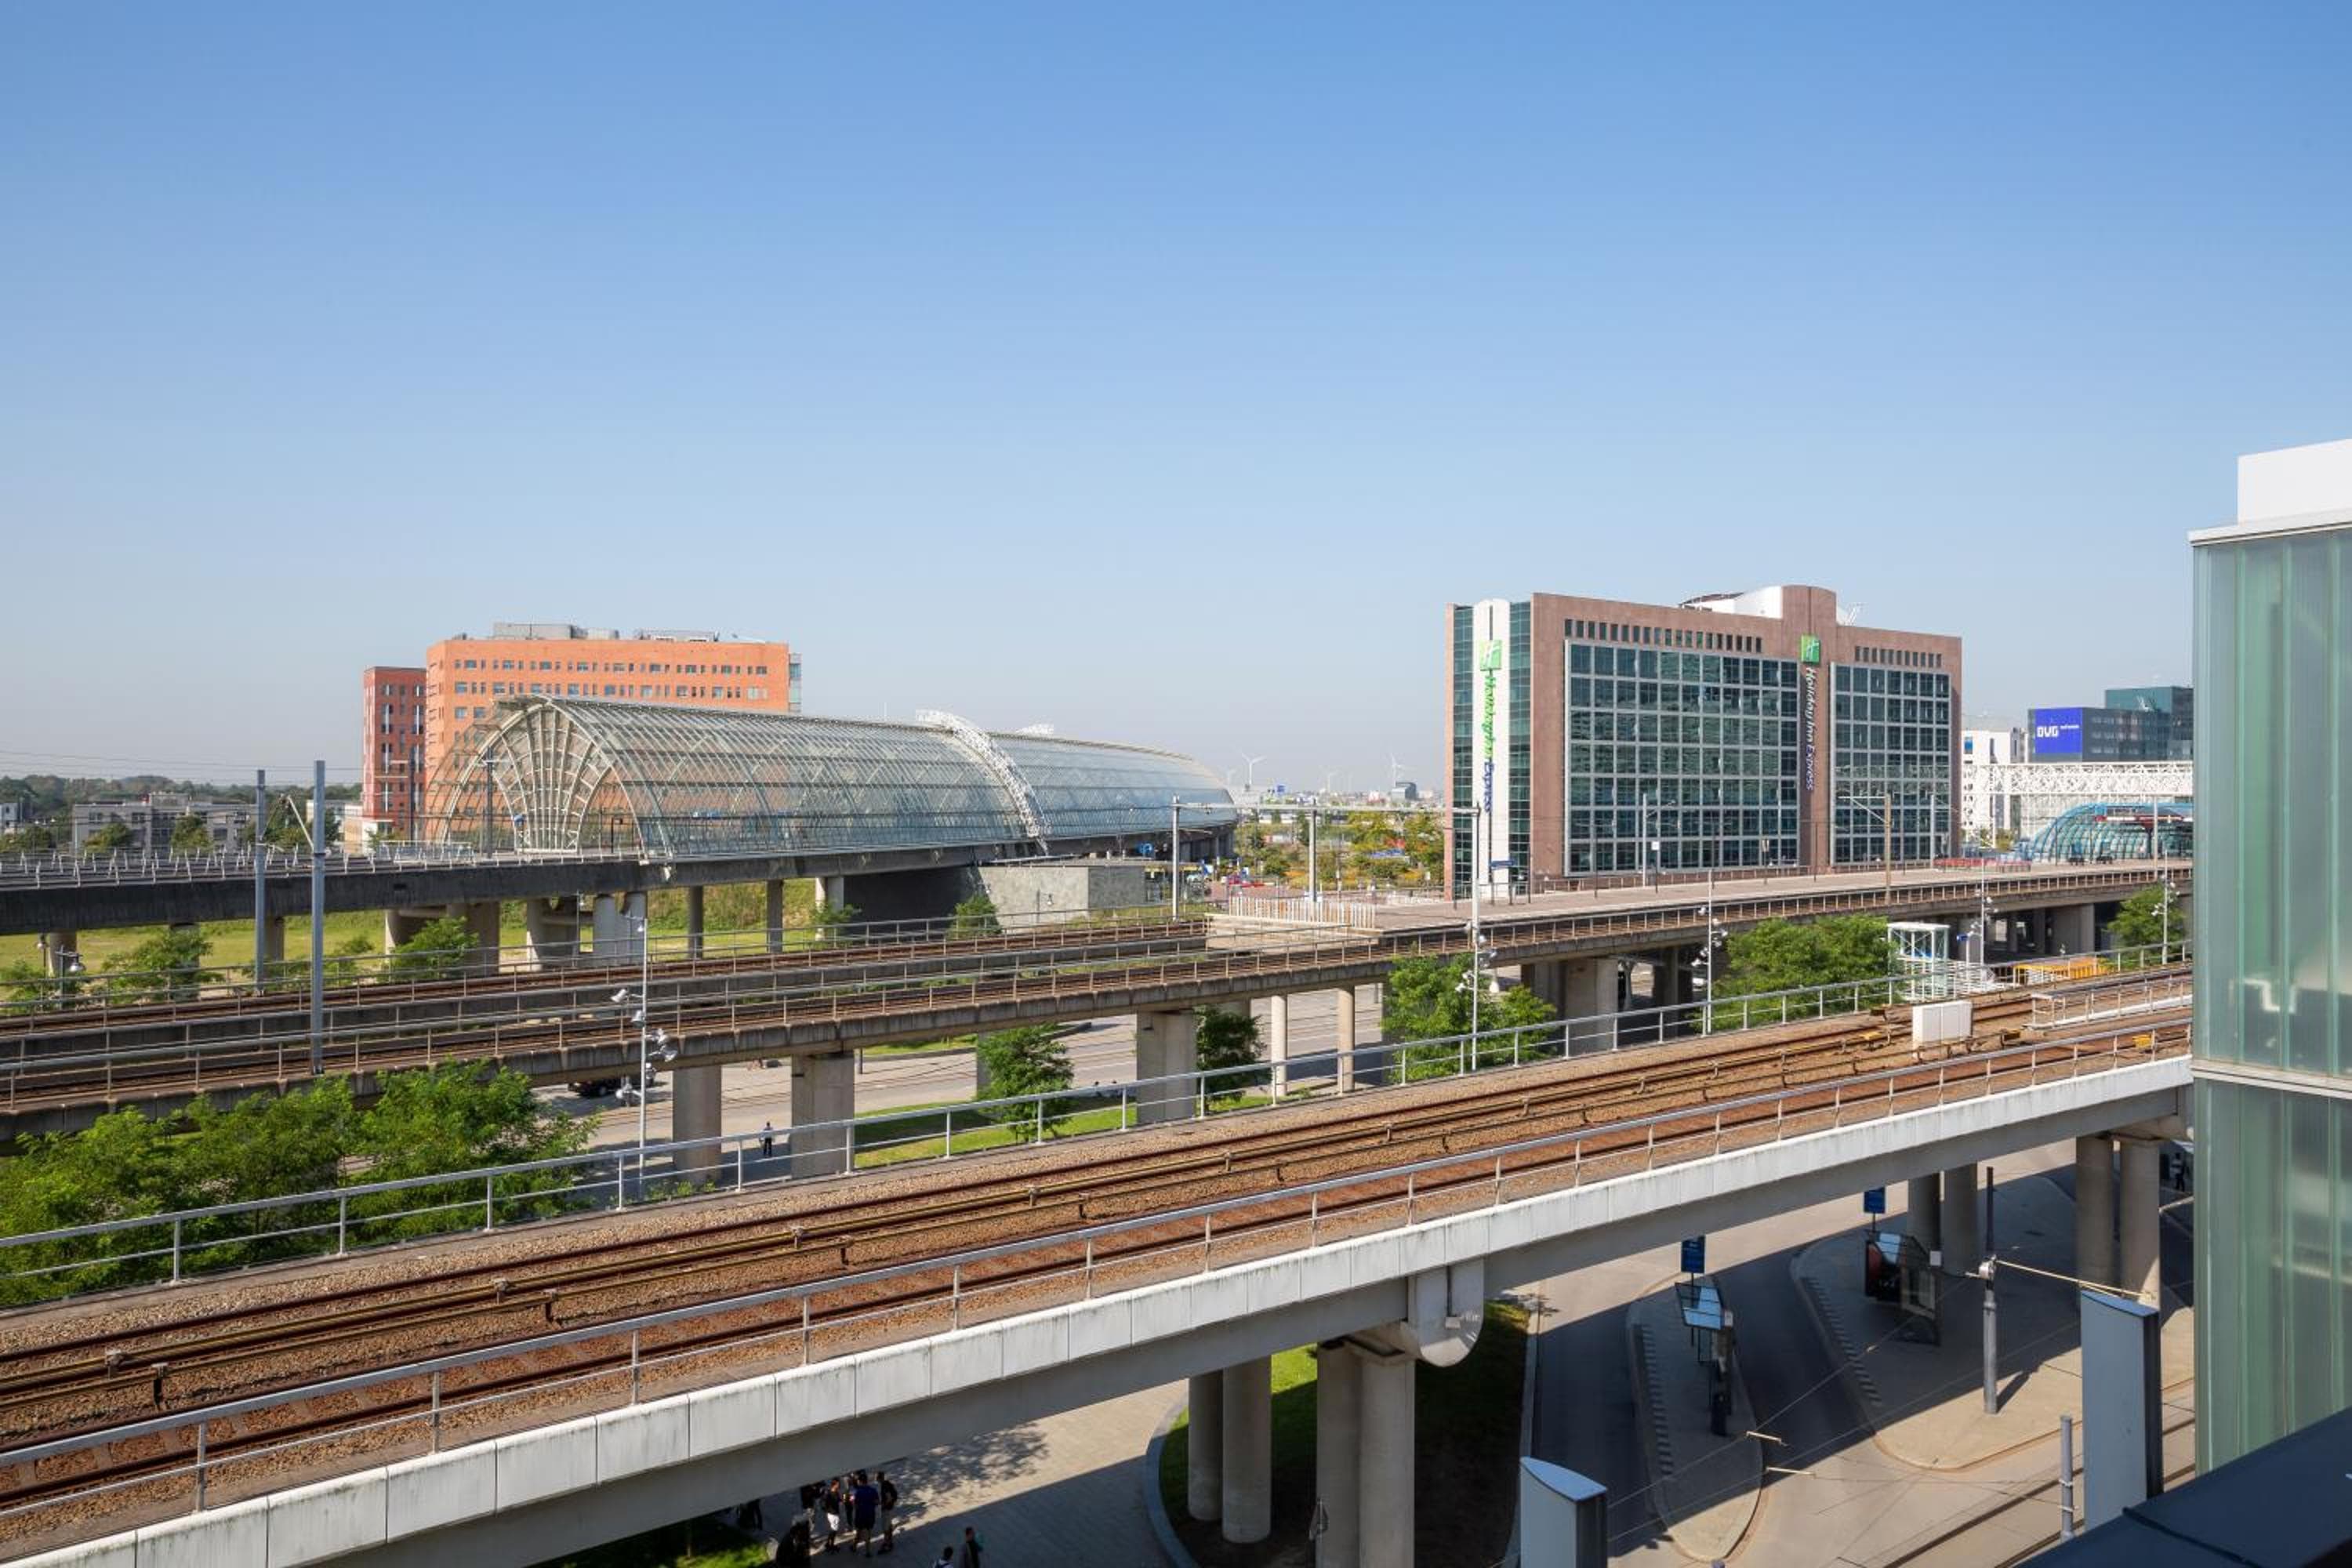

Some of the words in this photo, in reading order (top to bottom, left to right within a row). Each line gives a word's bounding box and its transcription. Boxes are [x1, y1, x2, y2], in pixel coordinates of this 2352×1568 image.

[1806, 667, 1816, 719] Holiday
[1806, 720, 1815, 742] Inn
[1806, 745, 1815, 790] Express
